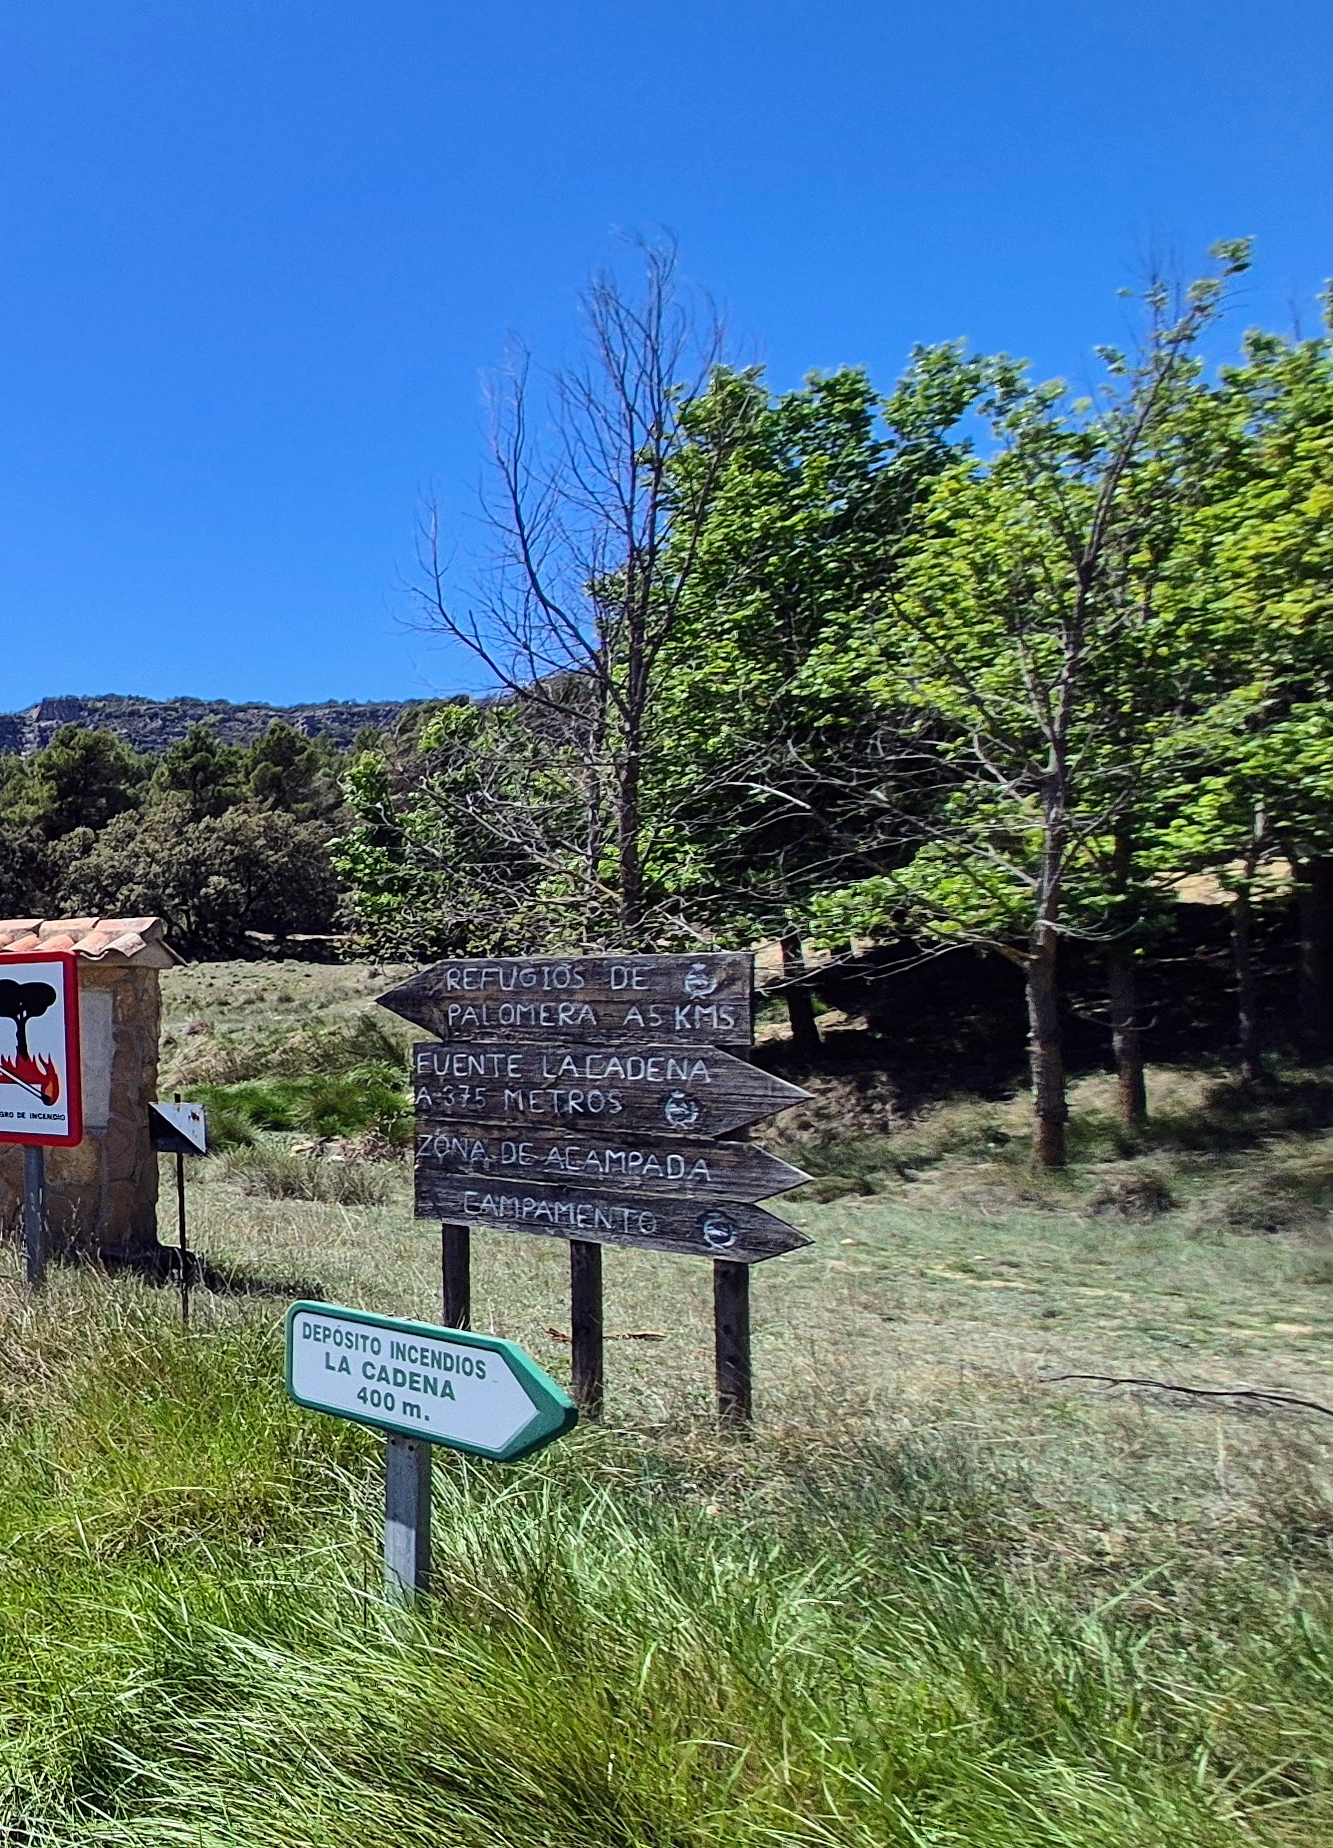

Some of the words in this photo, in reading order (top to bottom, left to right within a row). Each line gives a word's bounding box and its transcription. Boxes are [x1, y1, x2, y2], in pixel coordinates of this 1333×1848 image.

[445, 965, 584, 991] REFUGIOS
[610, 966, 650, 991] DE
[447, 1003, 598, 1027] PALOMERA
[674, 1003, 736, 1030] KMS
[415, 1052, 524, 1078] FUENTE
[413, 1086, 433, 1106] A
[442, 1085, 487, 1110] 375
[503, 1088, 624, 1115] METROS
[29, 1112, 66, 1121] INCENDIO
[415, 1134, 487, 1160] ZONA
[501, 1141, 533, 1165] DE
[544, 1146, 712, 1182] ACAMPADA
[463, 1190, 658, 1235] CAMPAMENTO
[302, 1320, 382, 1356] DEPÓSITO
[390, 1339, 487, 1380] INCENDIOS
[325, 1351, 351, 1376] LA
[361, 1361, 456, 1401] CADENA
[356, 1386, 396, 1412] 400
[402, 1400, 430, 1421] m.
